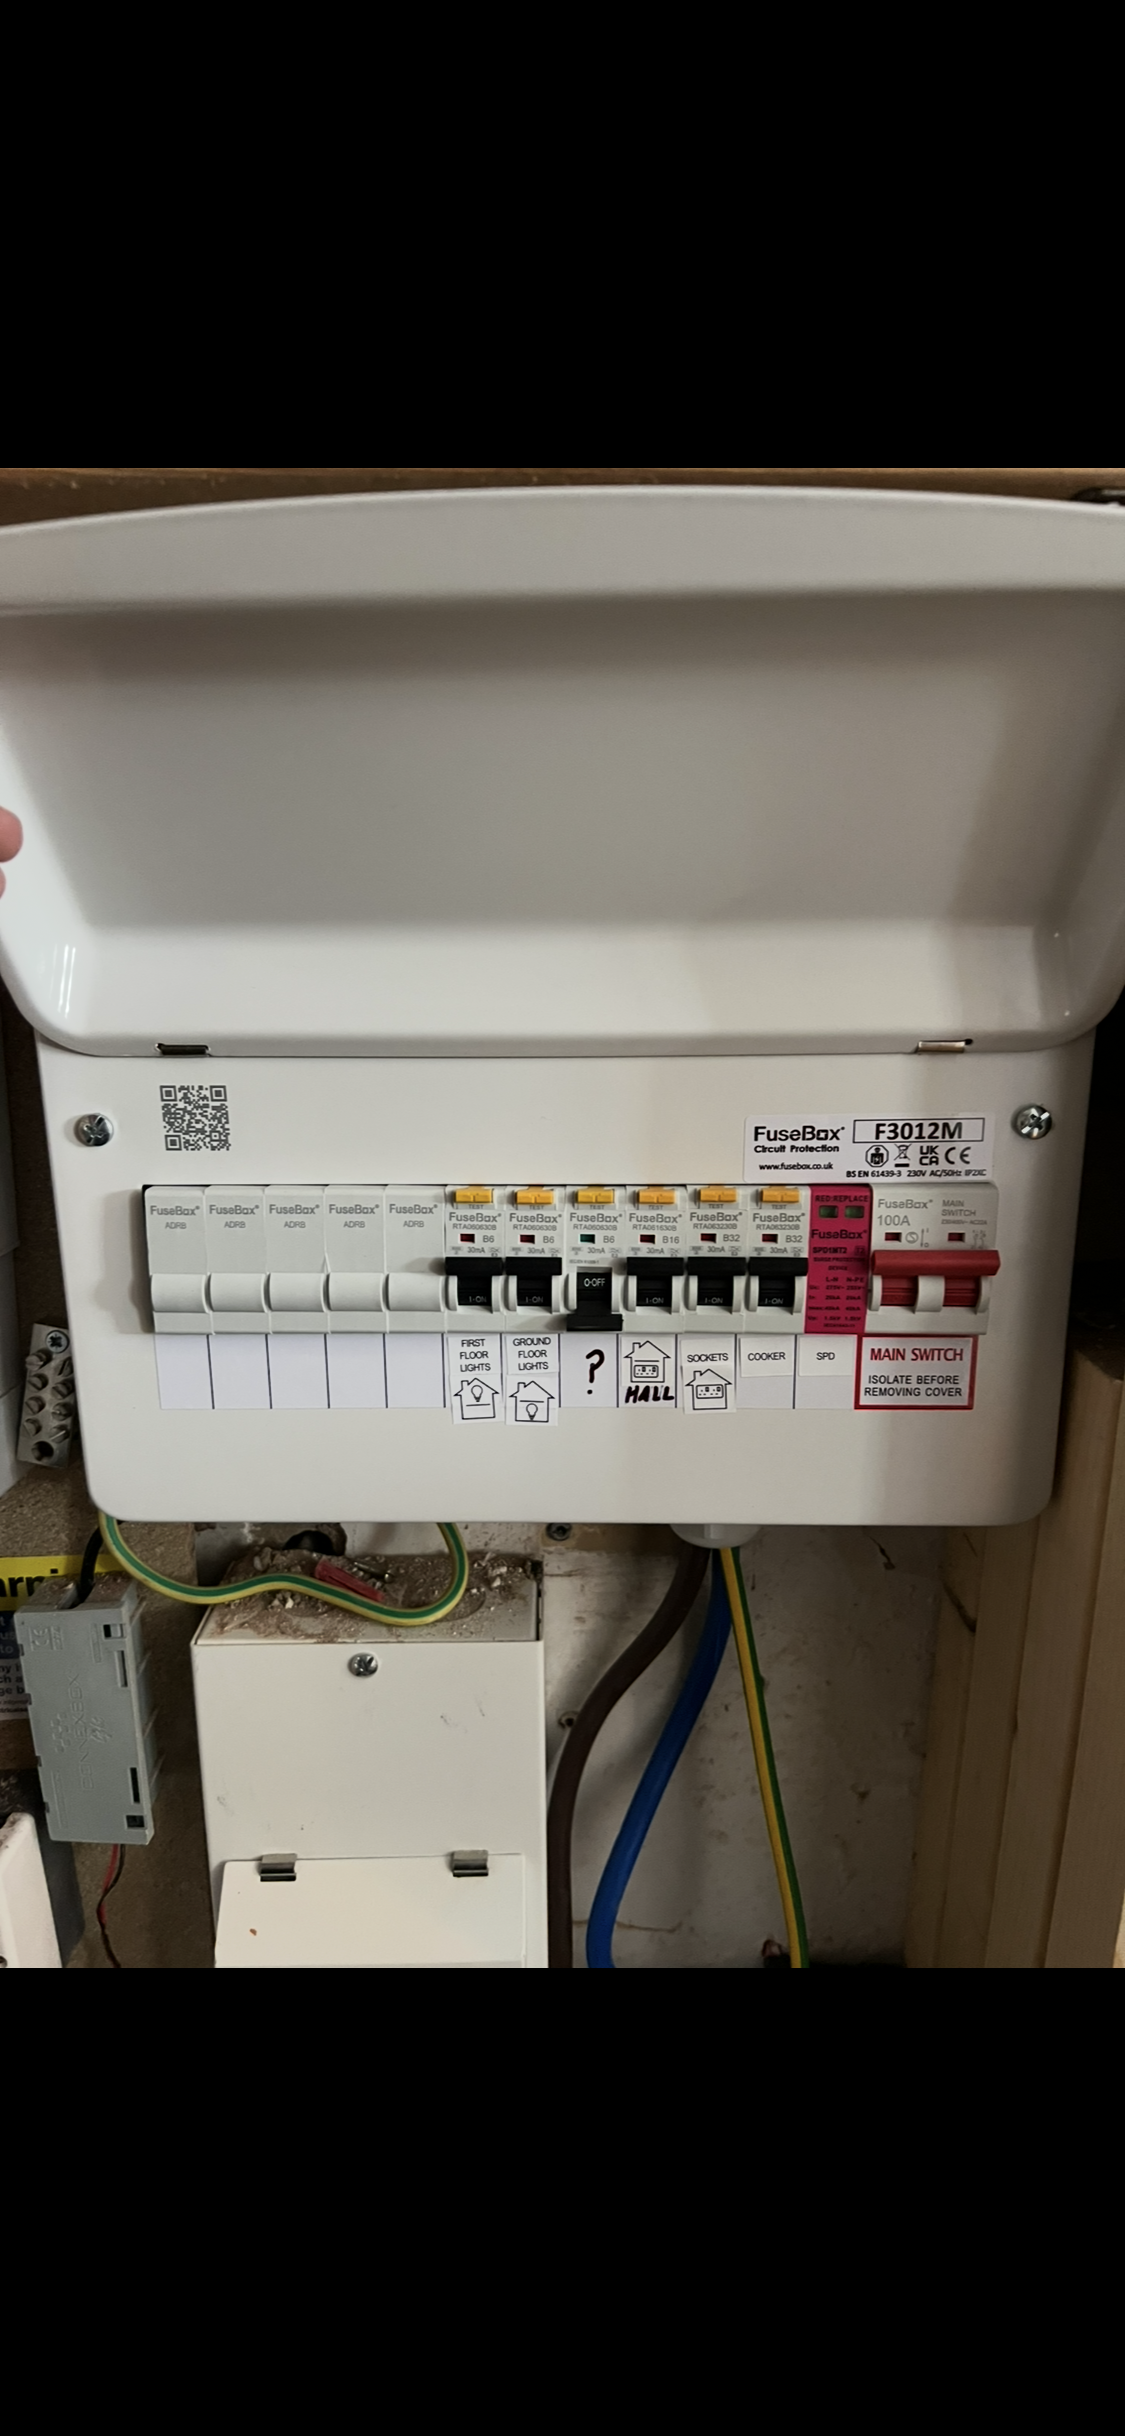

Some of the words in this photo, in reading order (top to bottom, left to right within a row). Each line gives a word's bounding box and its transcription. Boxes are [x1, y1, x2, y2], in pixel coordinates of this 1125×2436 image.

[754, 1125, 840, 1141] FuseBox
[875, 1122, 962, 1140] F3012M
[754, 1145, 786, 1153] Circuit
[790, 1144, 839, 1153] Protection
[759, 1162, 834, 1171] www.fusebox.co.uk
[846, 1170, 857, 1178] BS
[858, 1170, 869, 1178] EN
[871, 1169, 902, 1177] 61439-3
[907, 1169, 926, 1177] 230V
[929, 1169, 962, 1177] AC/50Hz
[328, 1204, 376, 1214] FuseBox
[388, 1204, 435, 1214] FuseBox
[877, 1199, 929, 1209] FuseBox
[150, 1205, 197, 1216] FuseBox
[209, 1204, 256, 1215] FuseBox
[269, 1204, 316, 1215] FuseBox
[449, 1212, 498, 1222] FuseBox
[509, 1213, 558, 1223] FuseBox
[570, 1213, 618, 1223] FuseBox
[629, 1213, 678, 1223] FuseBox
[690, 1212, 738, 1222] FuseBox
[753, 1213, 801, 1222] FuseBox
[877, 1215, 911, 1226] 100A
[483, 1235, 495, 1243] B6
[723, 1234, 740, 1242] B32
[785, 1235, 803, 1243] B32
[811, 1229, 863, 1239] FuseBox
[662, 1236, 680, 1244] B16
[461, 1338, 485, 1347] FIRST
[513, 1337, 551, 1346] GROUND
[460, 1351, 489, 1360] FLOOR
[518, 1350, 547, 1358] FLOOR
[687, 1353, 728, 1362] SOCKETS
[748, 1352, 786, 1361] COOKER
[816, 1352, 835, 1360] SPD
[870, 1348, 906, 1361] MAIN
[911, 1348, 963, 1361] SWITCH
[460, 1363, 491, 1372] LIGHTS
[518, 1361, 549, 1371] LIGHTS
[868, 1375, 913, 1384] ISOLATE
[916, 1374, 960, 1384] BEFORE
[624, 1385, 675, 1403] HALL
[864, 1387, 921, 1396] REMOVING
[924, 1387, 962, 1396] COVER
